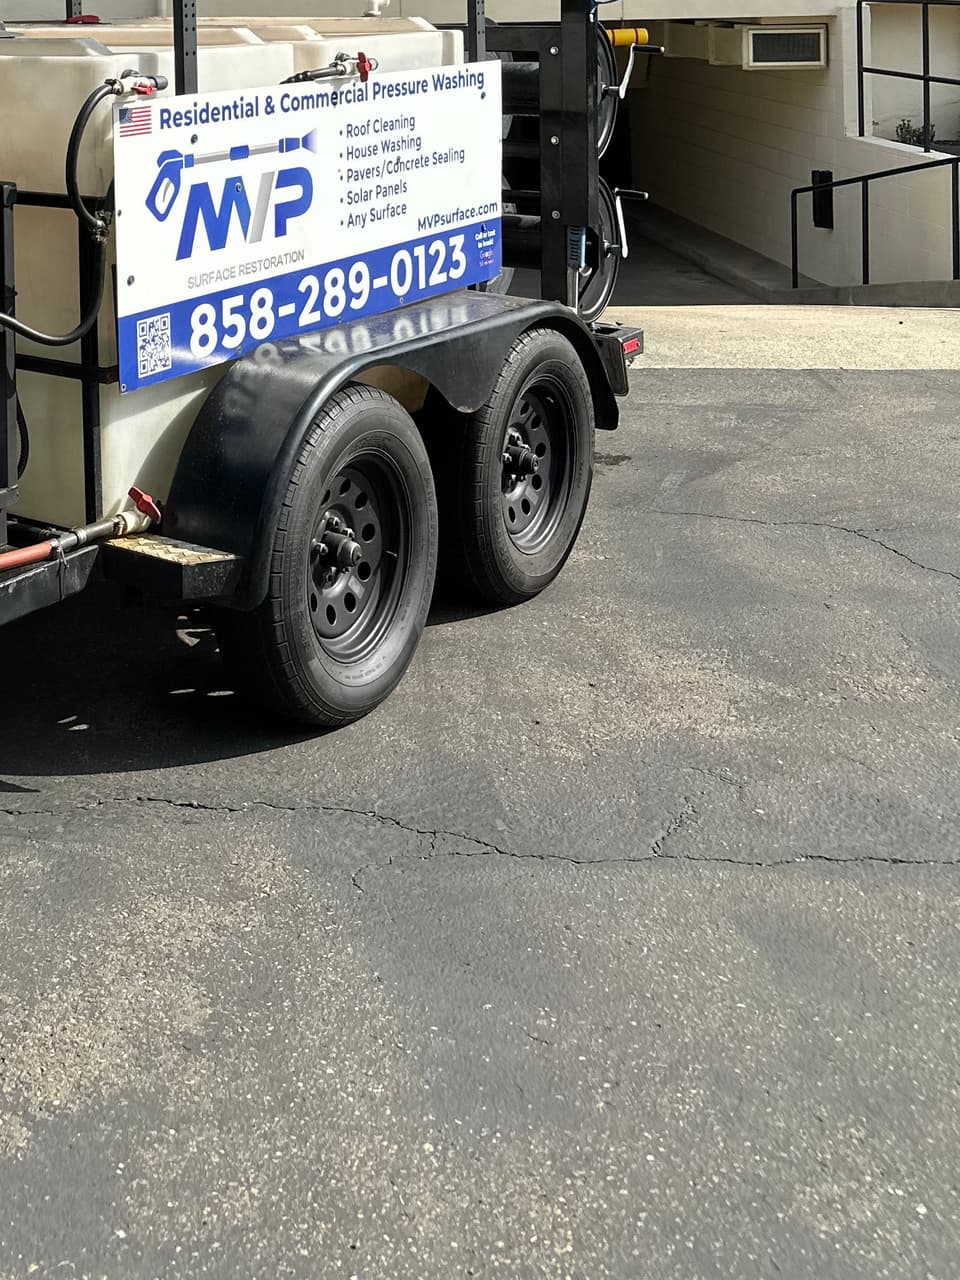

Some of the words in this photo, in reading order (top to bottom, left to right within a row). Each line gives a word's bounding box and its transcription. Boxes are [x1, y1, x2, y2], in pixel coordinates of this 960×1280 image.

[159, 95, 259, 130] Residential
[264, 95, 275, 115] &
[280, 83, 369, 113] Commercial
[372, 78, 428, 100] Pressure
[432, 68, 484, 91] Washing
[346, 119, 371, 138] Roof
[373, 114, 415, 134] Cleaning
[346, 144, 378, 160] House
[381, 135, 422, 154] Washing
[346, 155, 430, 183] Pavers/Concrete
[432, 147, 465, 164] Sealing
[346, 187, 373, 205] Solar
[375, 179, 408, 199] Panels
[175, 166, 314, 261] MVP
[346, 213, 367, 229] Any
[369, 203, 407, 222] Surface
[417, 201, 498, 232] MVPsurface.com
[187, 266, 236, 290] SURFACE
[238, 249, 305, 277] RESTORATION
[189, 233, 467, 358] 858-289-0123
